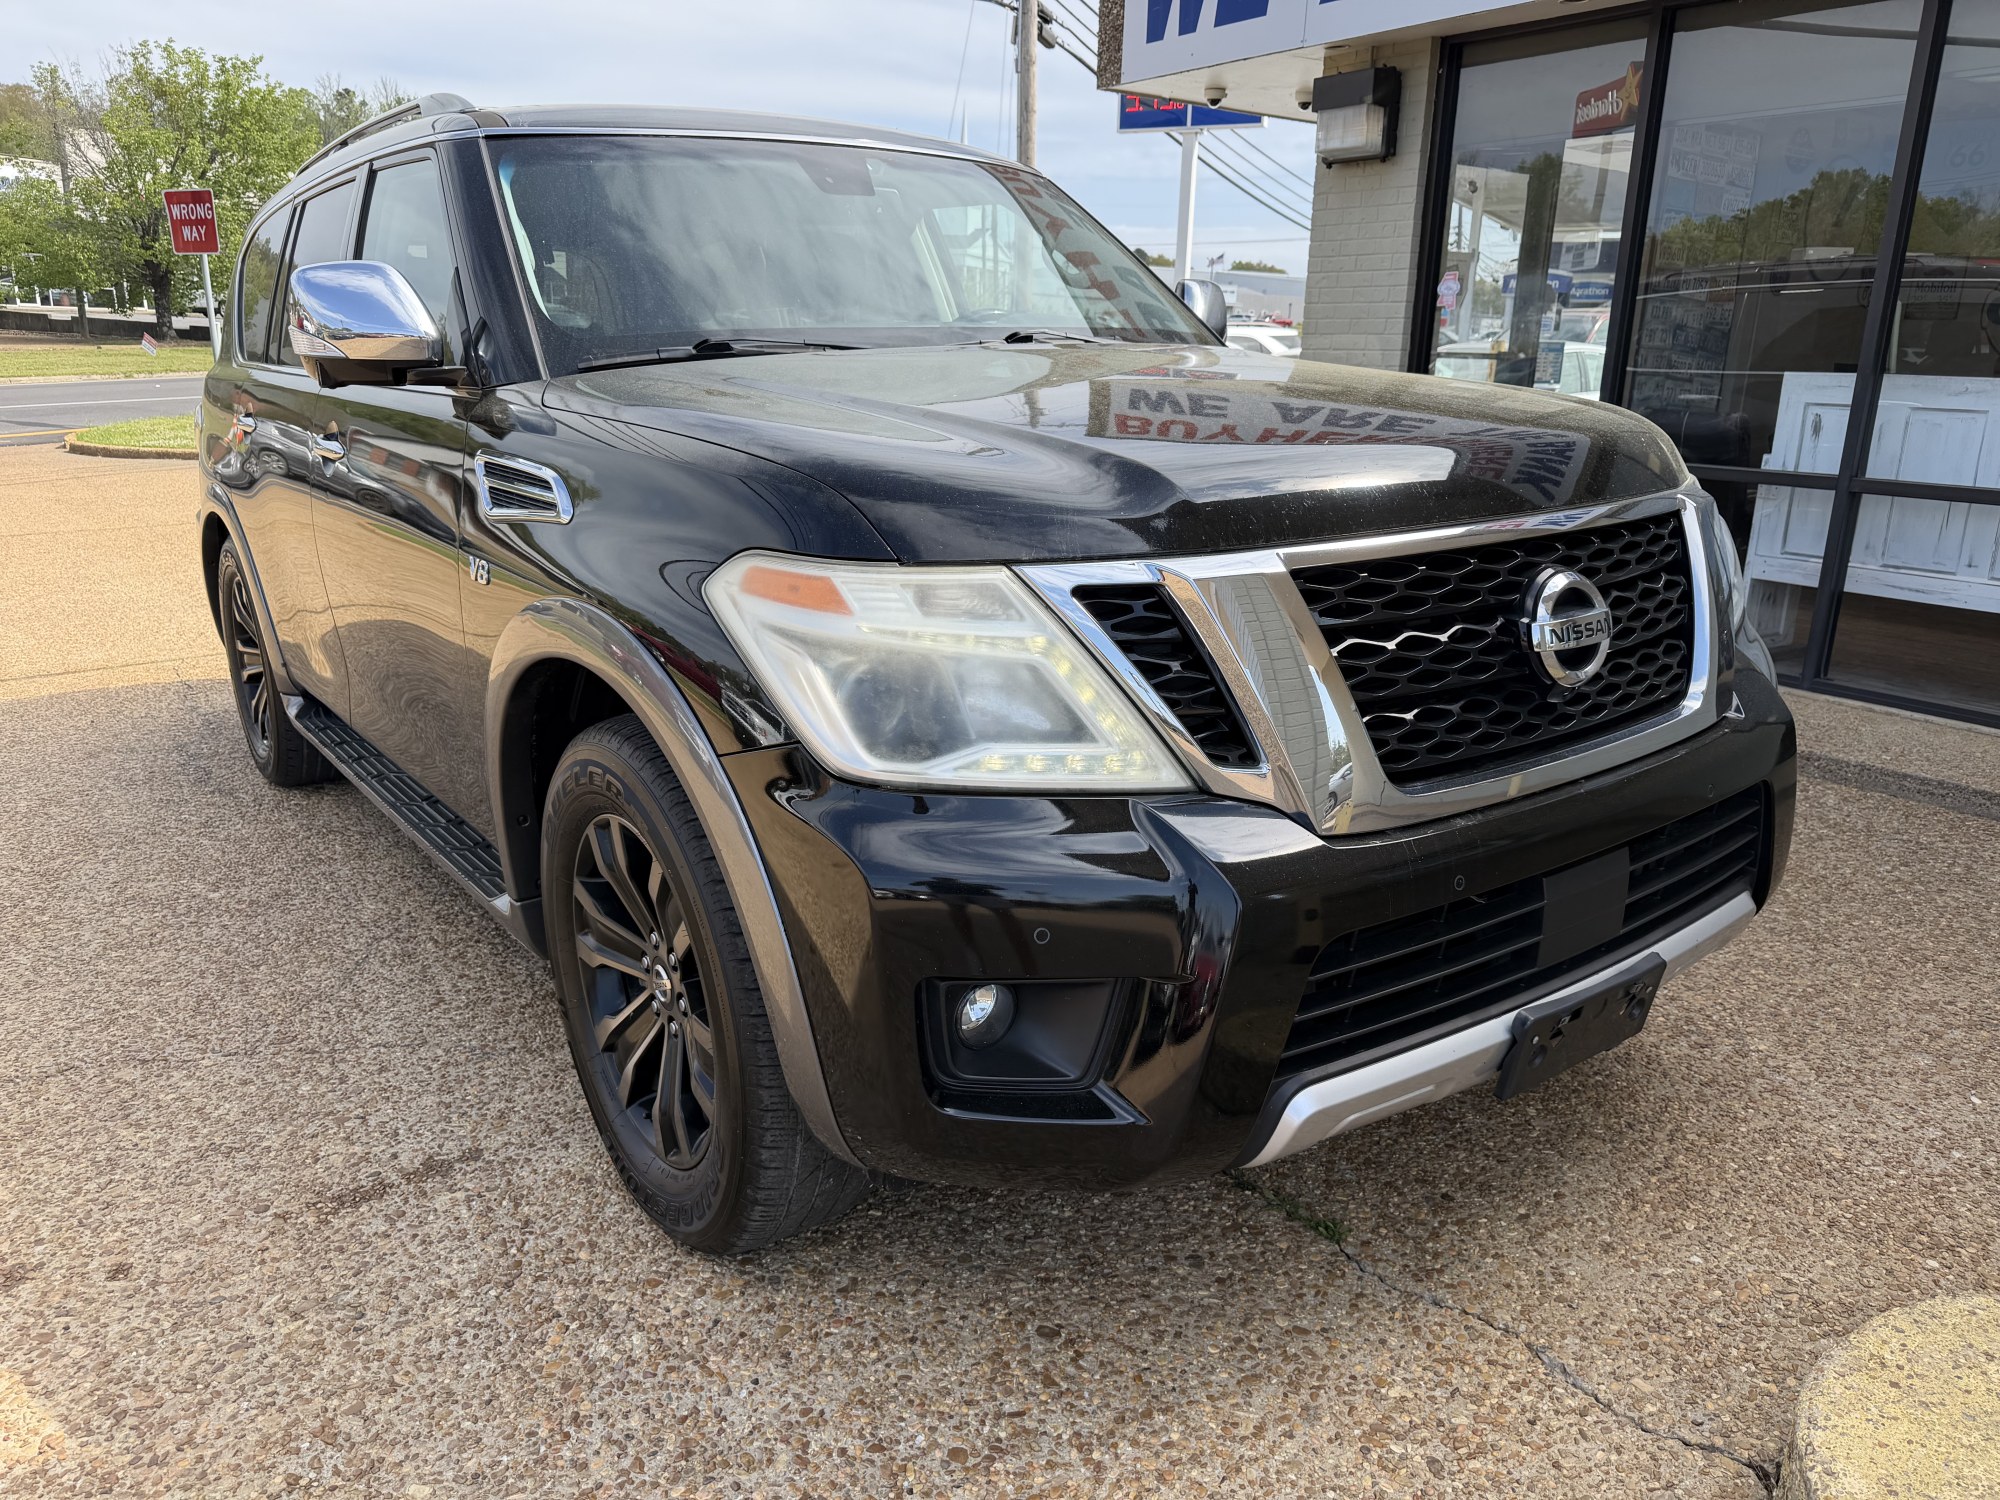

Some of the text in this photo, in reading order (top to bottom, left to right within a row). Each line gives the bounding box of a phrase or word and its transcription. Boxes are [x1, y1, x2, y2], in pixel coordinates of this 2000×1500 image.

[1949, 144, 1986, 168] 66
[170, 203, 213, 220] WRONG
[181, 225, 206, 241] WAY
[469, 556, 490, 585] V8
[1549, 617, 1612, 645] NISSAN
